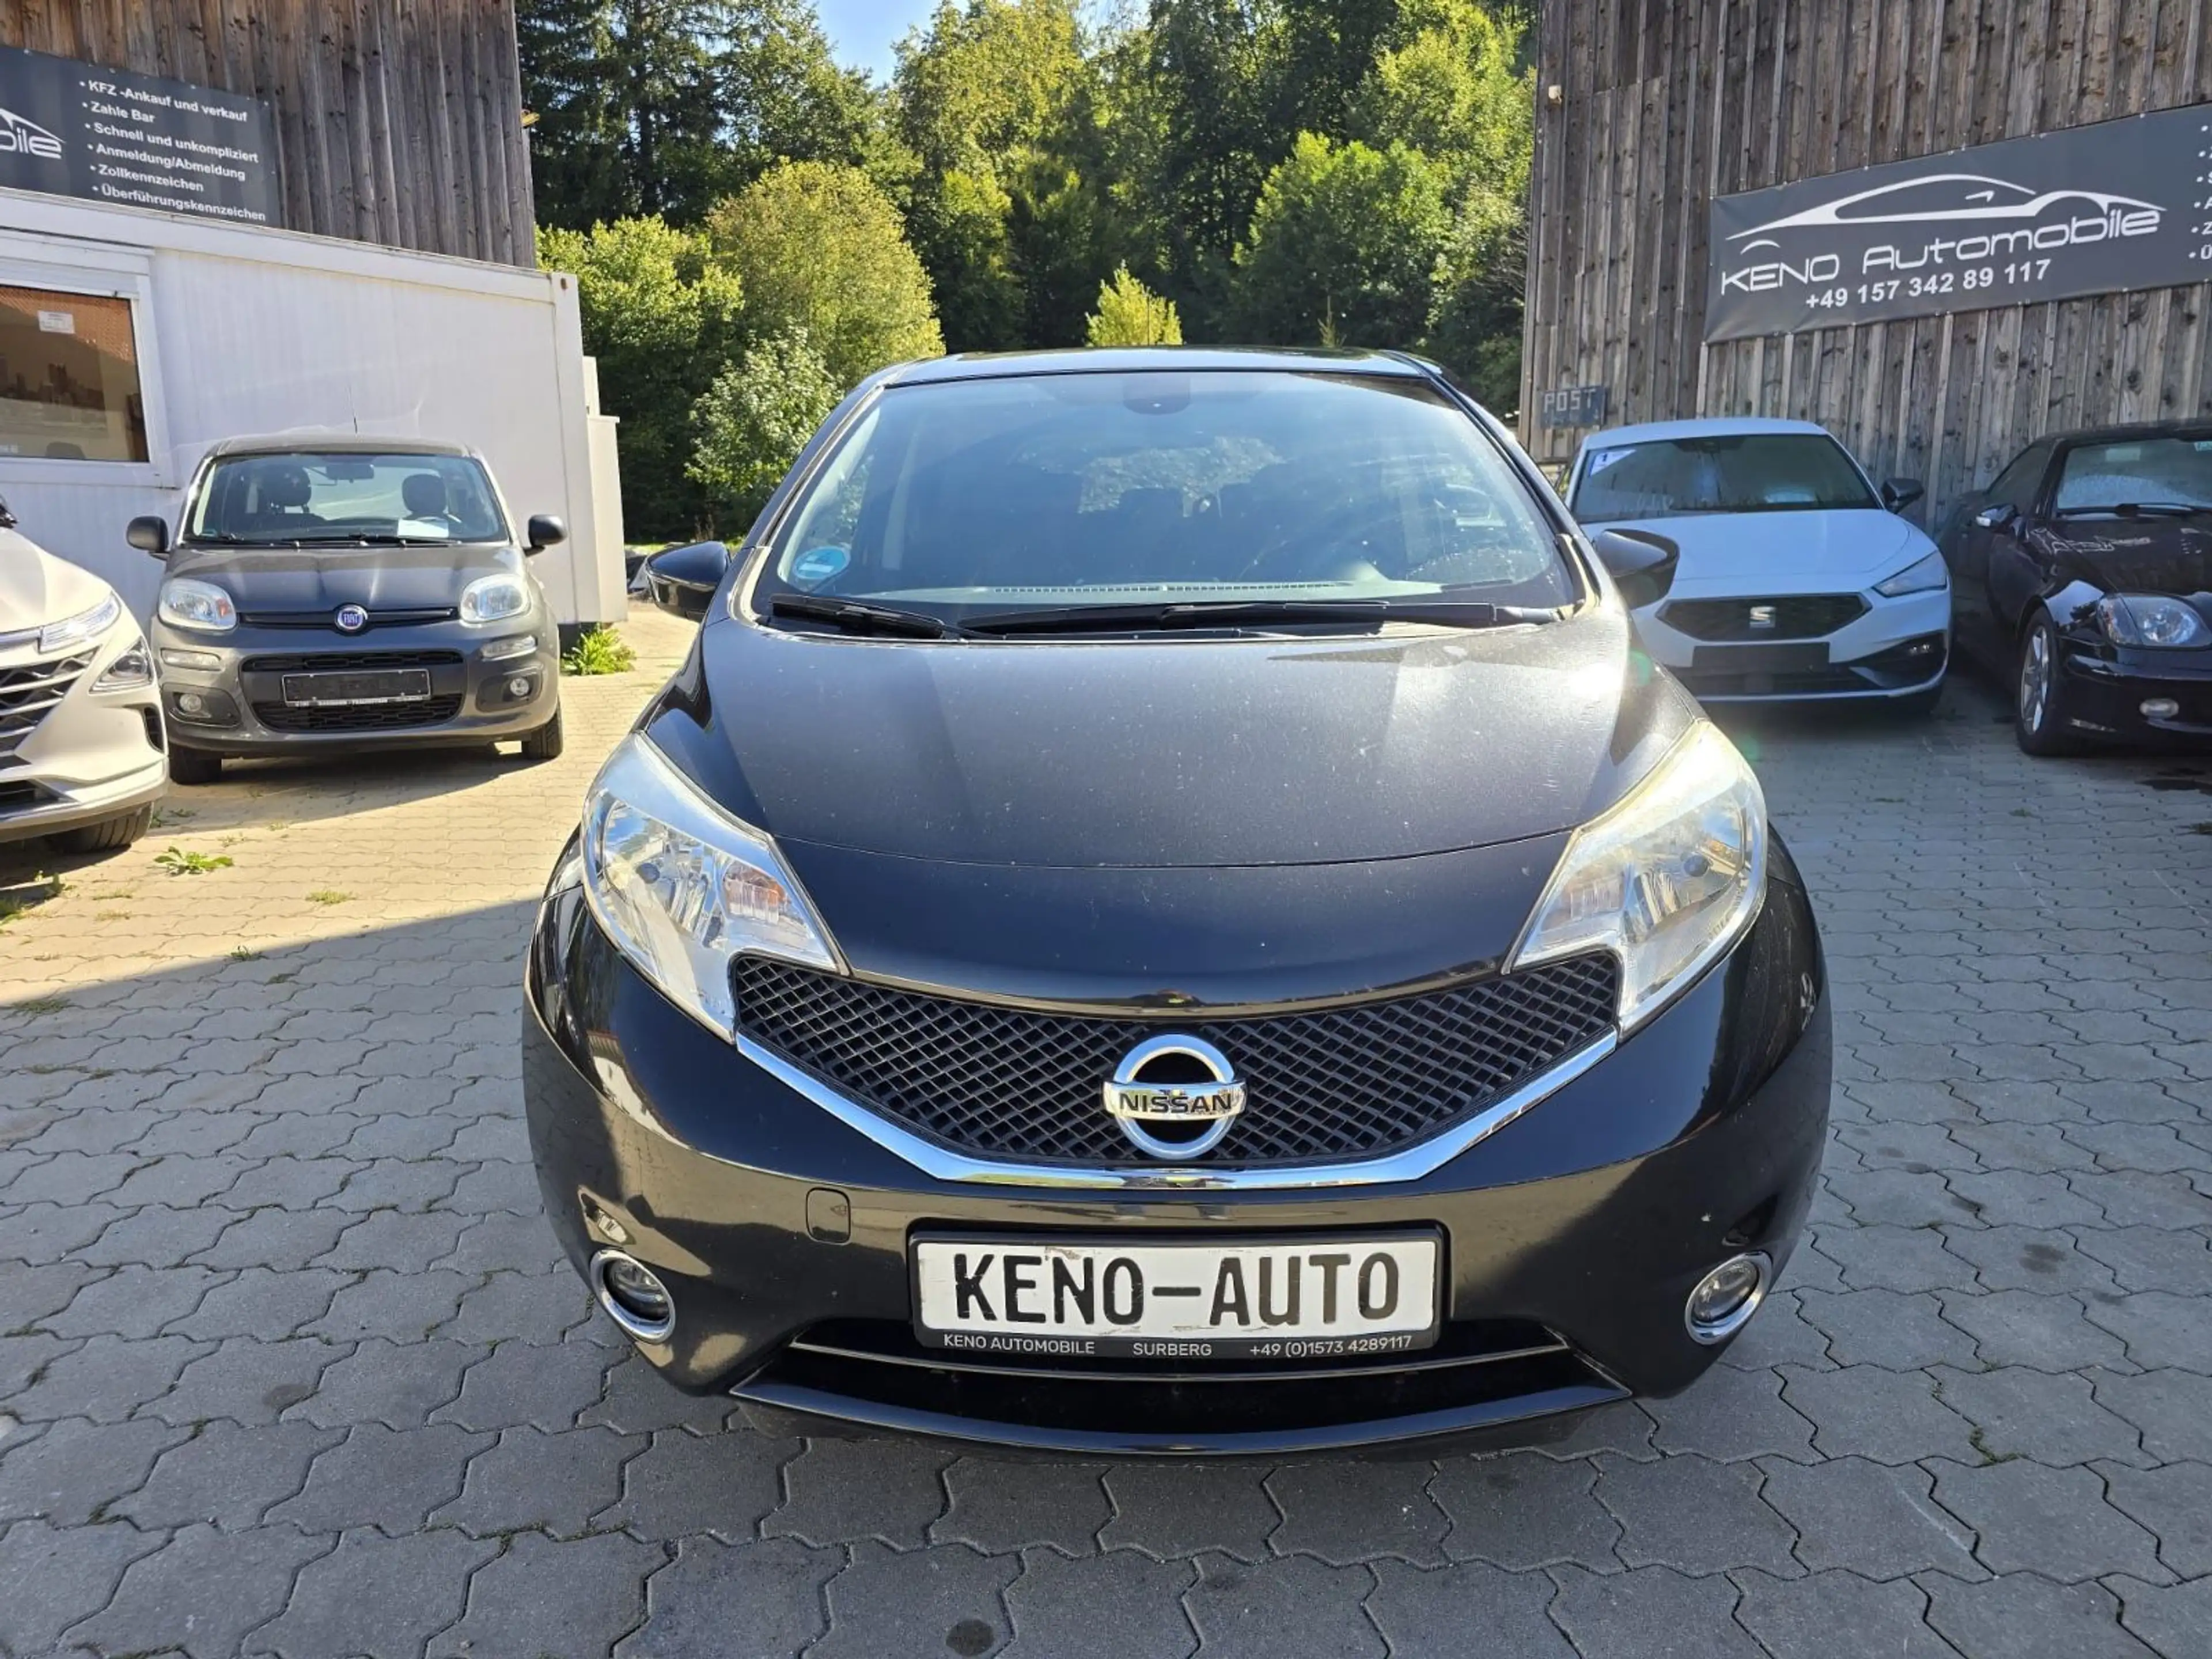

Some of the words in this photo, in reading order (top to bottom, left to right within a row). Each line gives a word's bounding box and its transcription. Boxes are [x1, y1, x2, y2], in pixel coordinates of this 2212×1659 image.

[88, 79, 117, 96] KFZ
[174, 99, 199, 112] und
[201, 105, 247, 122] verkauf
[90, 100, 128, 118] Zahle
[131, 109, 155, 123] Bar
[94, 122, 143, 142] Schnell
[147, 134, 172, 146] und
[175, 139, 259, 164] unkompliziert
[97, 143, 245, 181] Anmeldung/Abmeldung
[99, 164, 204, 191] Zollkennzeichen
[1721, 254, 1839, 296] KENO
[1862, 209, 2160, 275] Automobile
[1806, 287, 1848, 308] +49
[1858, 280, 1900, 303] 157
[1908, 272, 1954, 297] 342
[1963, 267, 1994, 289] 89
[2005, 259, 2051, 284] 117
[1544, 388, 1596, 413] POST
[1120, 1093, 1232, 1113] NISSAN
[944, 1334, 987, 1349] KENO
[990, 1337, 1095, 1354] AUTOMOBILE
[1133, 1343, 1212, 1356] SURBERG
[1250, 1343, 1281, 1356] +49
[1285, 1341, 1344, 1357] (0)1573
[1348, 1335, 1412, 1353] 4289117
